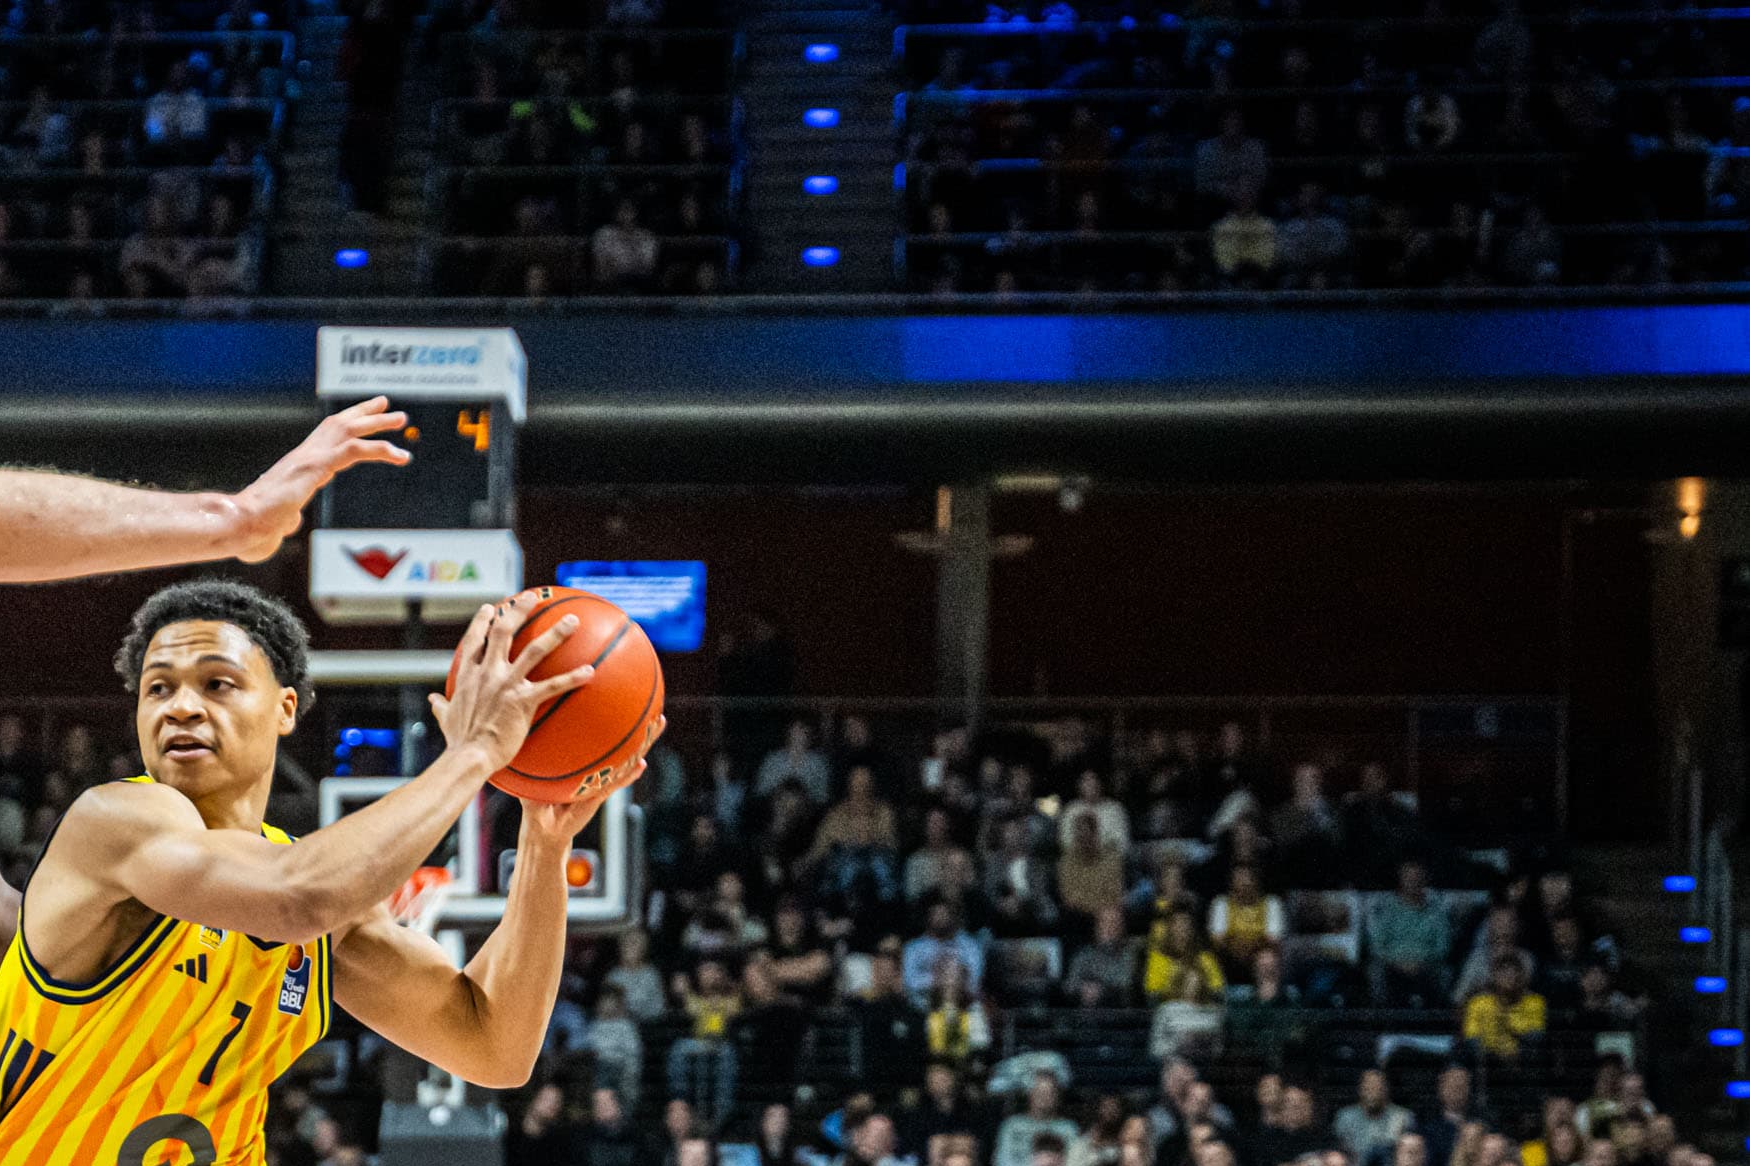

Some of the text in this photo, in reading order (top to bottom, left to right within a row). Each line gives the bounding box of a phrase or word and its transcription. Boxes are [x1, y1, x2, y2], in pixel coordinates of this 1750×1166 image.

[408, 559, 480, 582] AIDA
[280, 989, 302, 1010] BBL
[198, 1000, 252, 1086] 7
